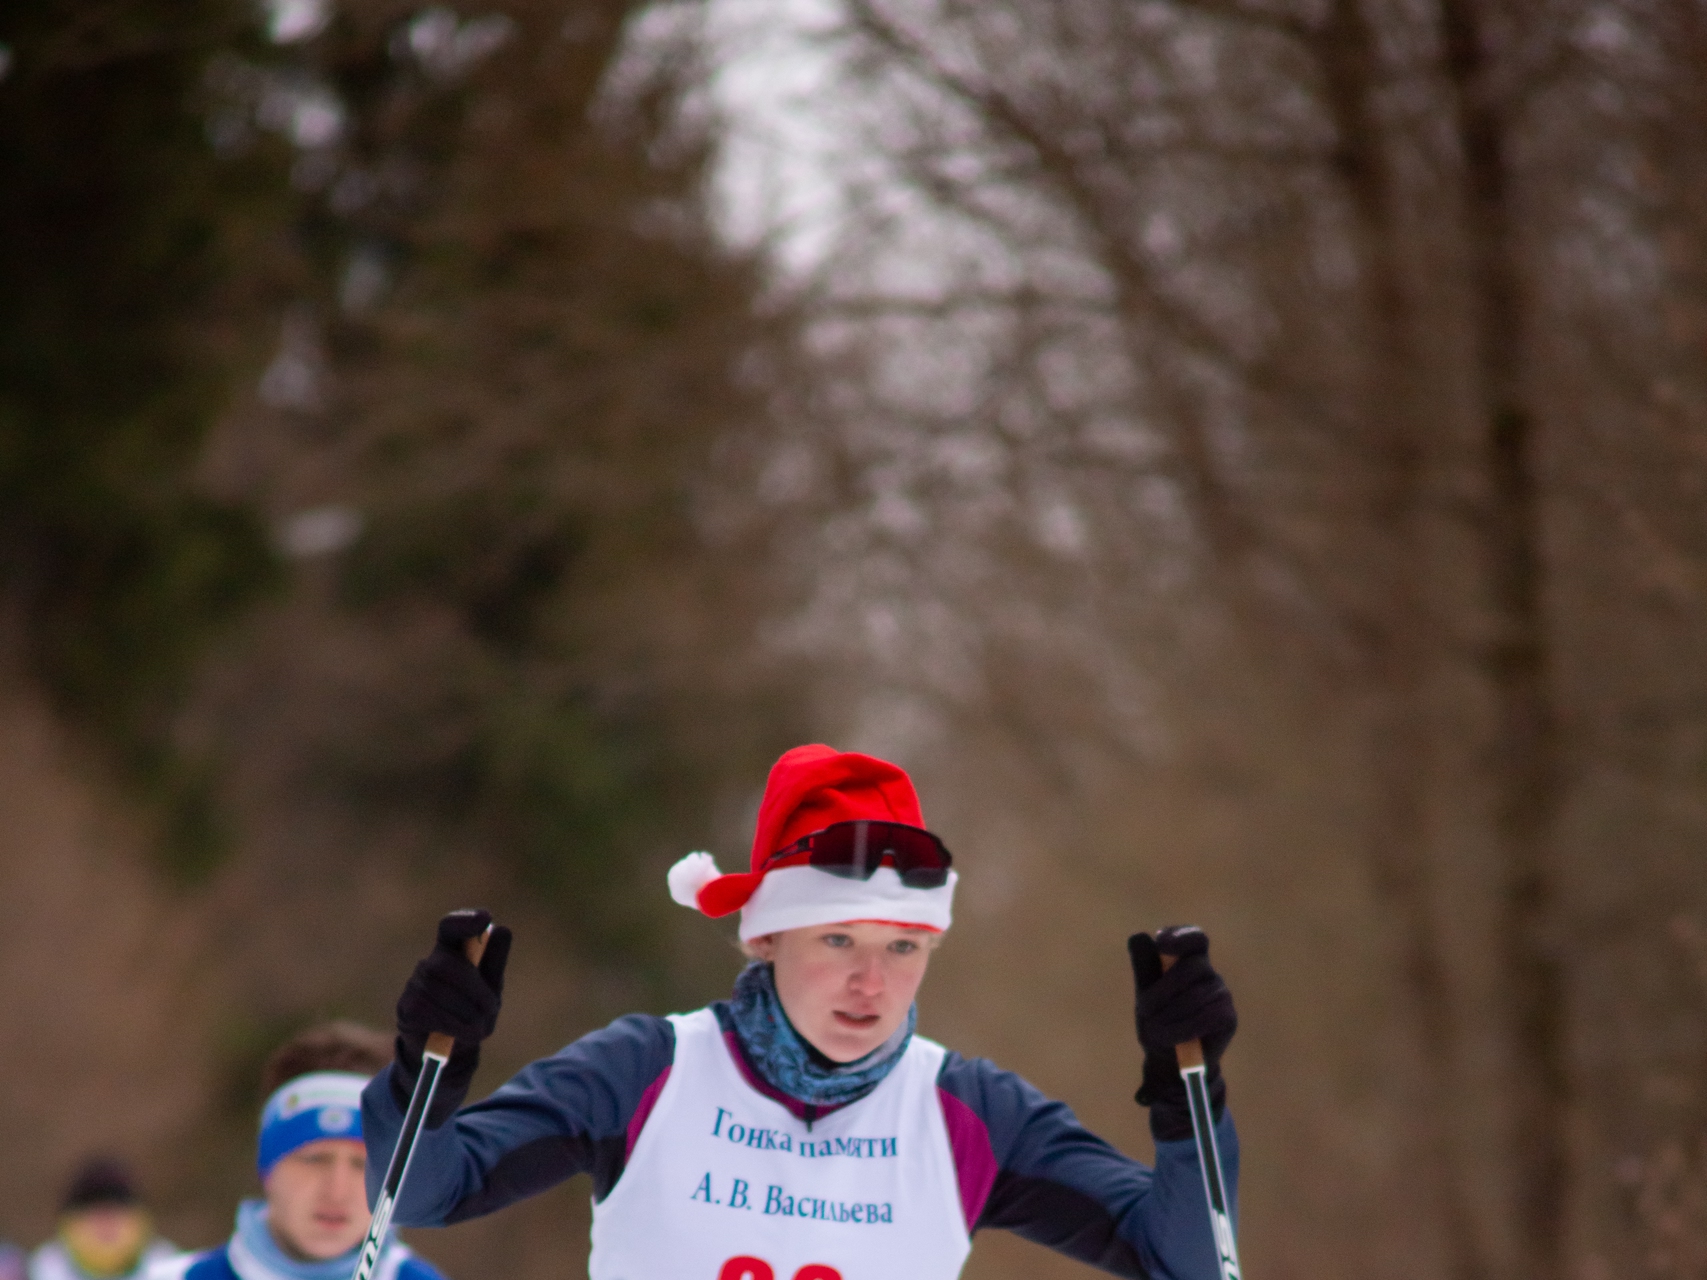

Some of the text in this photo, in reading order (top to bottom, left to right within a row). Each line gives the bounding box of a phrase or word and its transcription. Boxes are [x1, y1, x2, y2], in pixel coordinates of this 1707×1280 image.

[711, 1106, 898, 1159] Гонка памяти
[763, 1184, 894, 1224] Васильева
